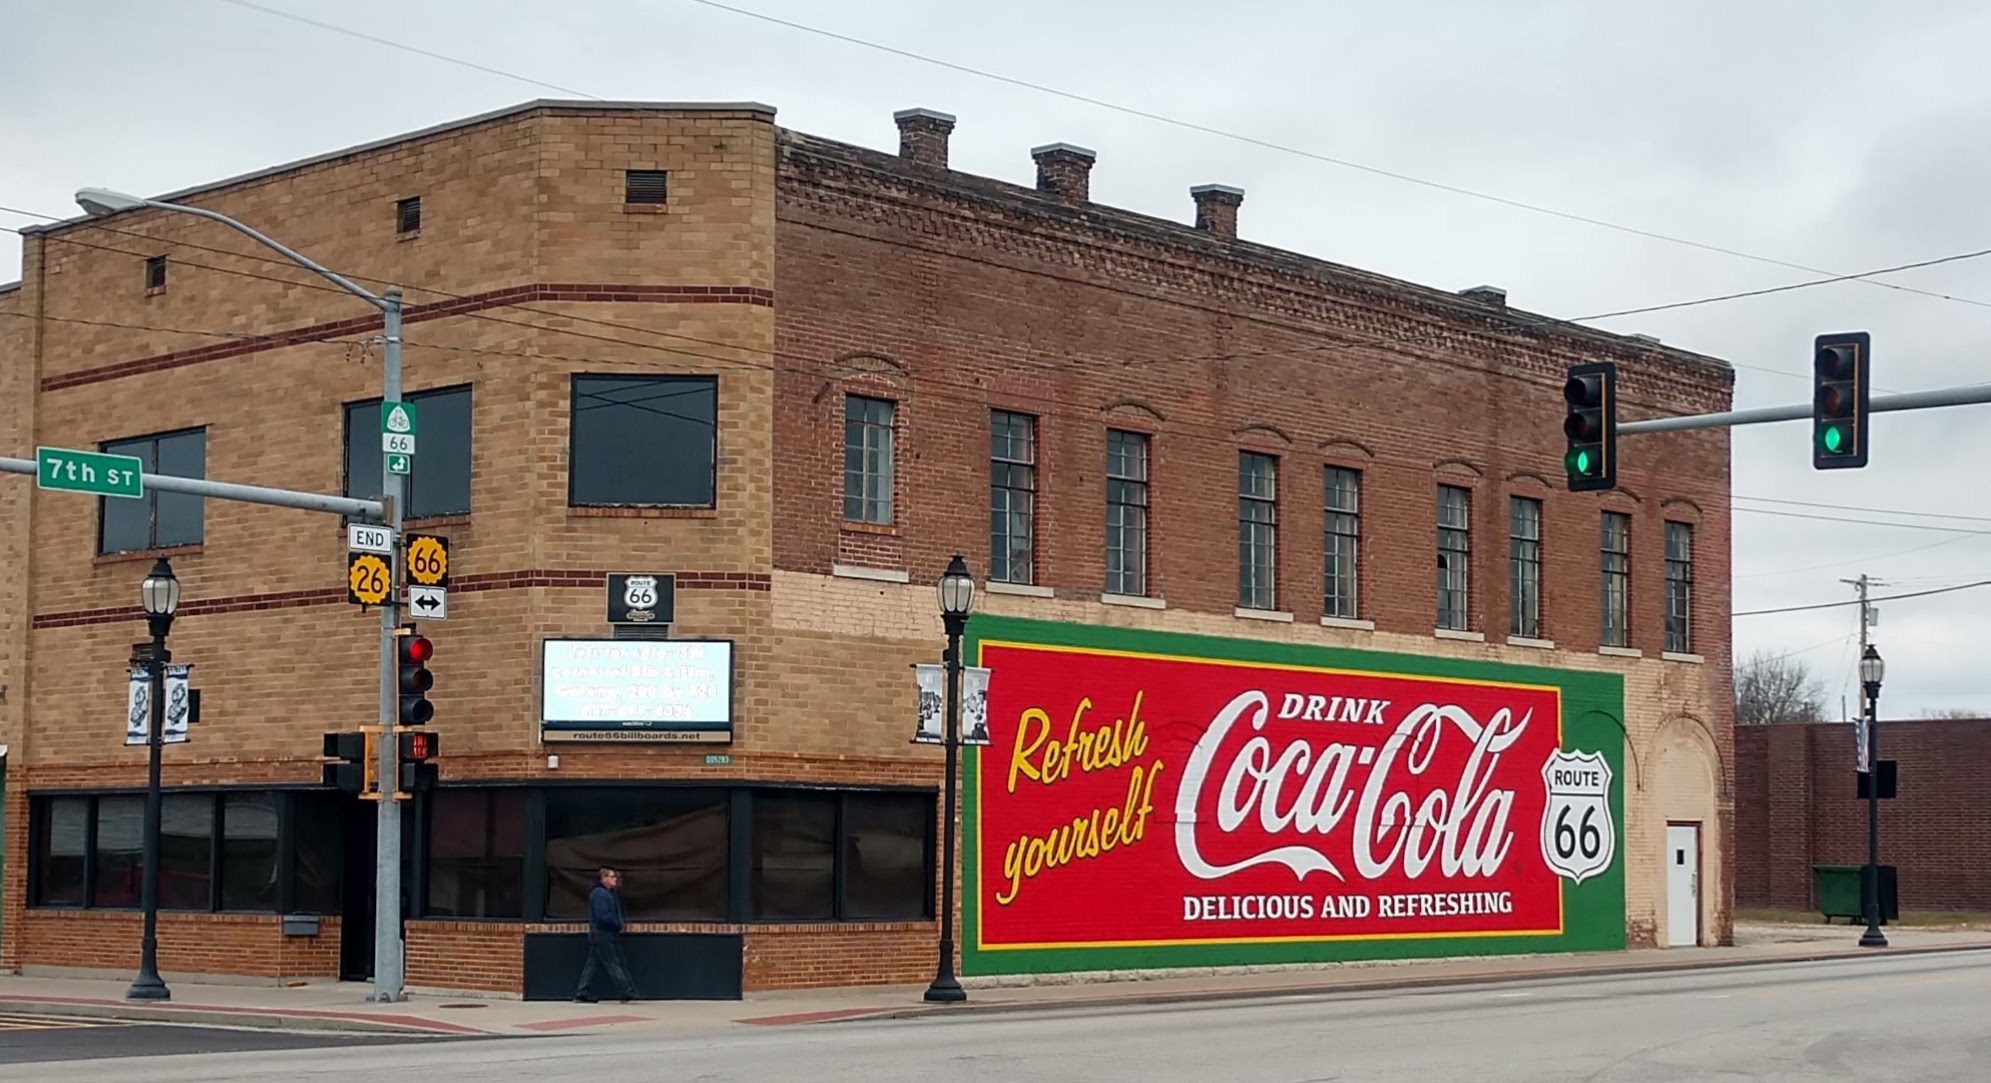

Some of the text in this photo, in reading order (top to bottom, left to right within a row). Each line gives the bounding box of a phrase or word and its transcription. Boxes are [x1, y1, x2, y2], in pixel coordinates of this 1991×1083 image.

[389, 436, 408, 450] 66
[46, 458, 134, 486] 7th ST
[356, 531, 385, 546] END
[414, 547, 441, 575] 66
[356, 565, 384, 594] 26
[629, 588, 652, 604] 66
[1277, 693, 1391, 725] DRINK
[573, 731, 701, 740] route66billboards.net
[1008, 690, 1149, 793] Refresh
[1175, 690, 1534, 883] Coca-Cola
[1554, 769, 1600, 787] ROUTE
[995, 759, 1165, 906] yourself
[1554, 804, 1601, 859] 66
[1183, 891, 1513, 921] DELICIOUS AND REFRESHING
